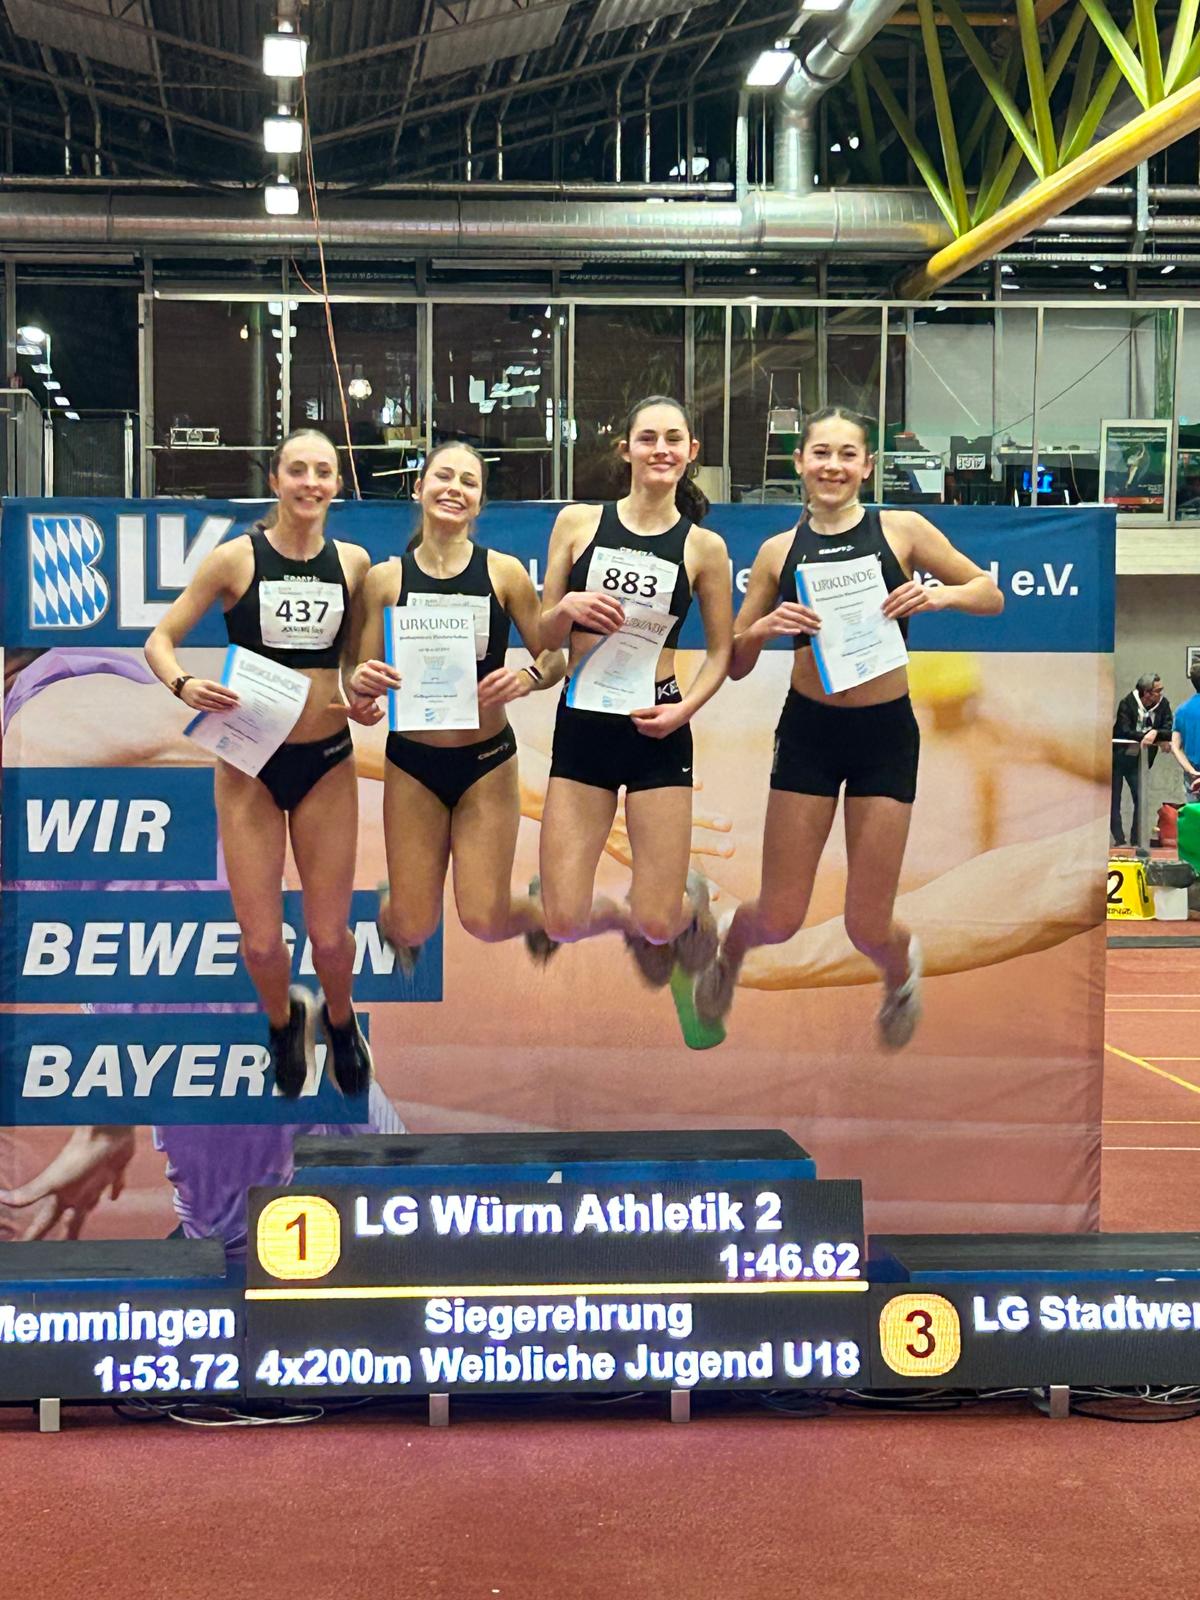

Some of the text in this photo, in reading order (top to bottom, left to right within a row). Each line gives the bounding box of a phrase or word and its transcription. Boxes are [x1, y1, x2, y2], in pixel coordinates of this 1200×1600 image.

[602, 567, 658, 598] 883
[812, 568, 876, 593] URKUNDE
[1011, 563, 1079, 596] e.V.
[275, 599, 329, 623] 437
[400, 618, 469, 631] URKUNDE
[26, 799, 171, 852] WIR
[1106, 869, 1124, 904] 2
[22, 921, 396, 976] BEWEN
[355, 1191, 783, 1235] LG Würm Athletik 2
[285, 1212, 307, 1261] 1
[719, 1242, 861, 1278] 1:46.62
[424, 1296, 693, 1340] Siegerehrung
[973, 1295, 1030, 1332] LG
[905, 1309, 937, 1359] 3
[94, 1353, 240, 1392] 1:53.72
[255, 1341, 860, 1387] 4x200m Weibliche Jugend U18
